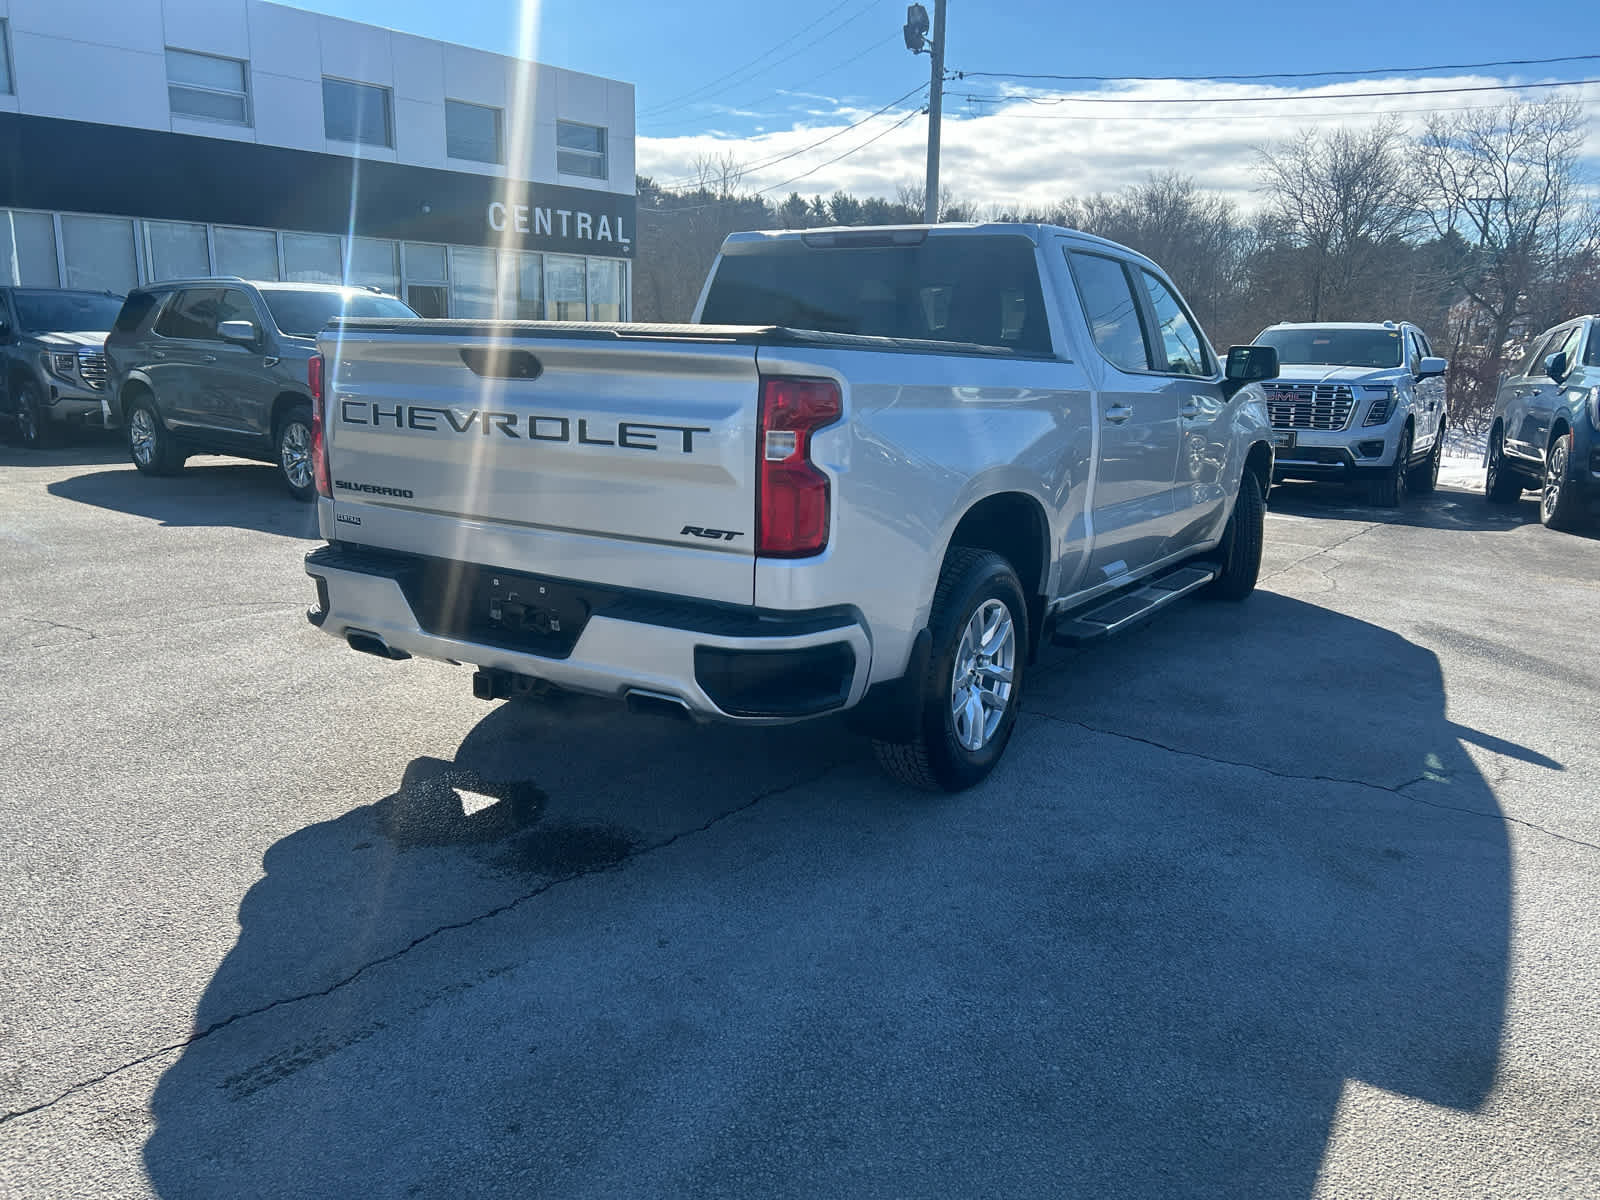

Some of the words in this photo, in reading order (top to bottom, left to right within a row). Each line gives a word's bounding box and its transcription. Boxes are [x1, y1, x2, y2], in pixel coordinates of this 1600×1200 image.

[488, 202, 630, 243] CENTRAL
[341, 400, 711, 453] CHEVROLET
[335, 480, 414, 498] SILVERADO
[680, 526, 744, 540] RST
